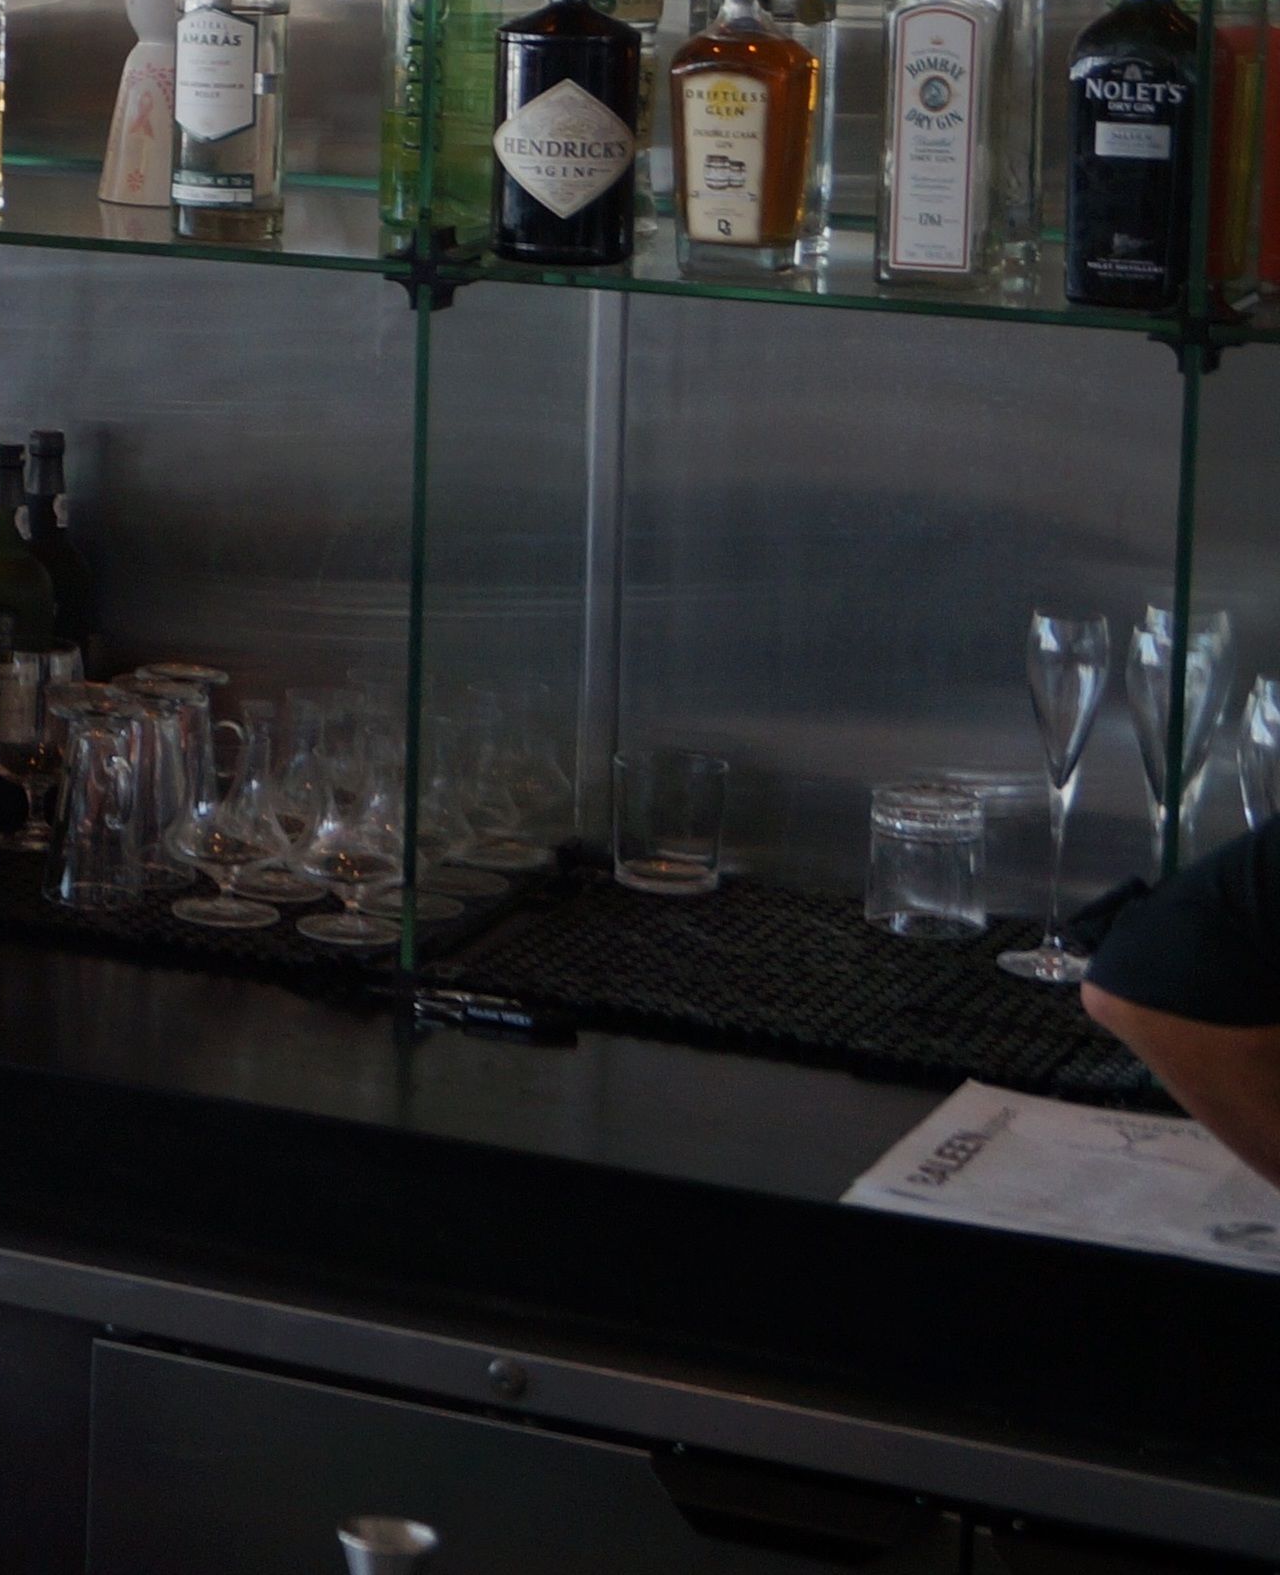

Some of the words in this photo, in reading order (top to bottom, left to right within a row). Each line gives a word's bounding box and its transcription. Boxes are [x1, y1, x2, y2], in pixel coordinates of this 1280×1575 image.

[904, 55, 967, 83] BOMBAY
[685, 87, 768, 104] DRIFTLESS
[1084, 78, 1183, 105] NOLET'S
[705, 105, 745, 118] GLEN
[1107, 100, 1133, 113] DRY
[1133, 101, 1156, 114] GIN
[904, 107, 933, 130] DRY
[935, 109, 965, 131] GIN
[503, 136, 628, 159] HENDRICK'S
